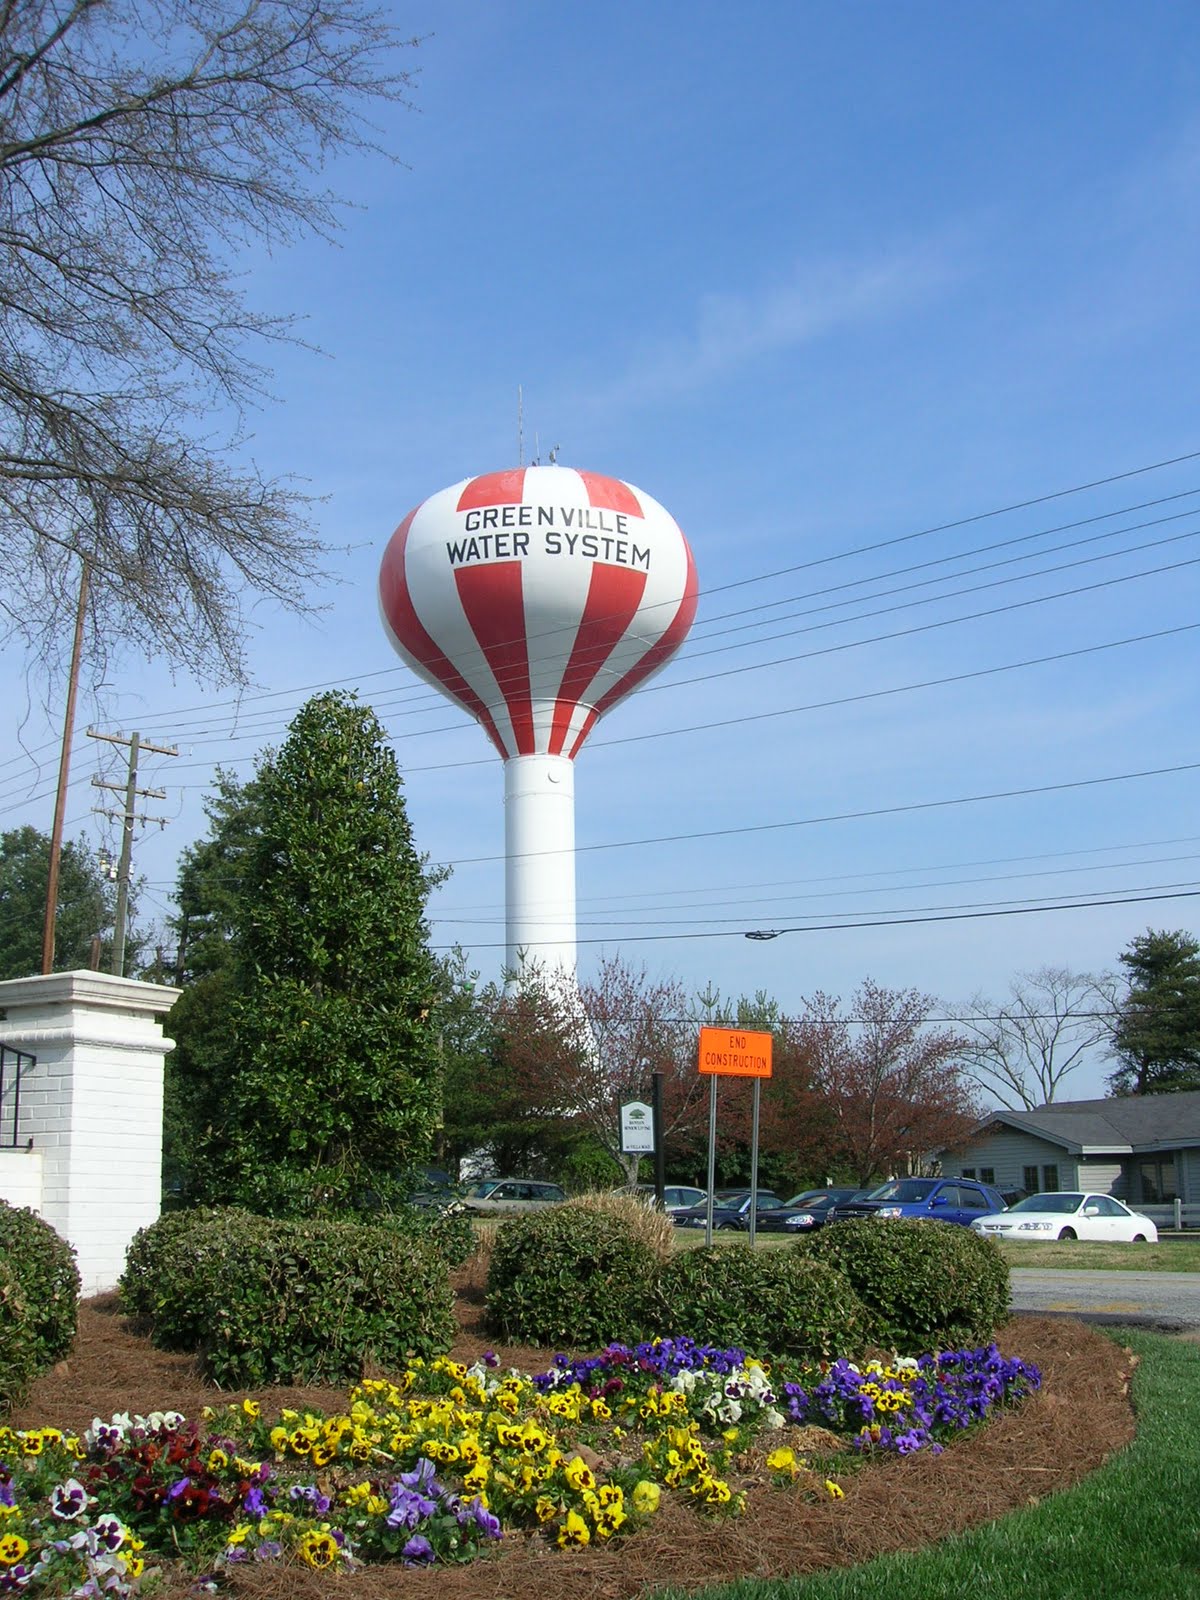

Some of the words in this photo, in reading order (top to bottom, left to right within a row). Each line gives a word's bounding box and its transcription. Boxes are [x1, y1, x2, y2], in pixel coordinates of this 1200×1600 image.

[465, 506, 629, 535] GREENVILLE
[446, 532, 530, 565] WATER
[545, 532, 651, 570] SYSTEM
[729, 1035, 747, 1049] END
[705, 1052, 767, 1069] CONSTRUCTION
